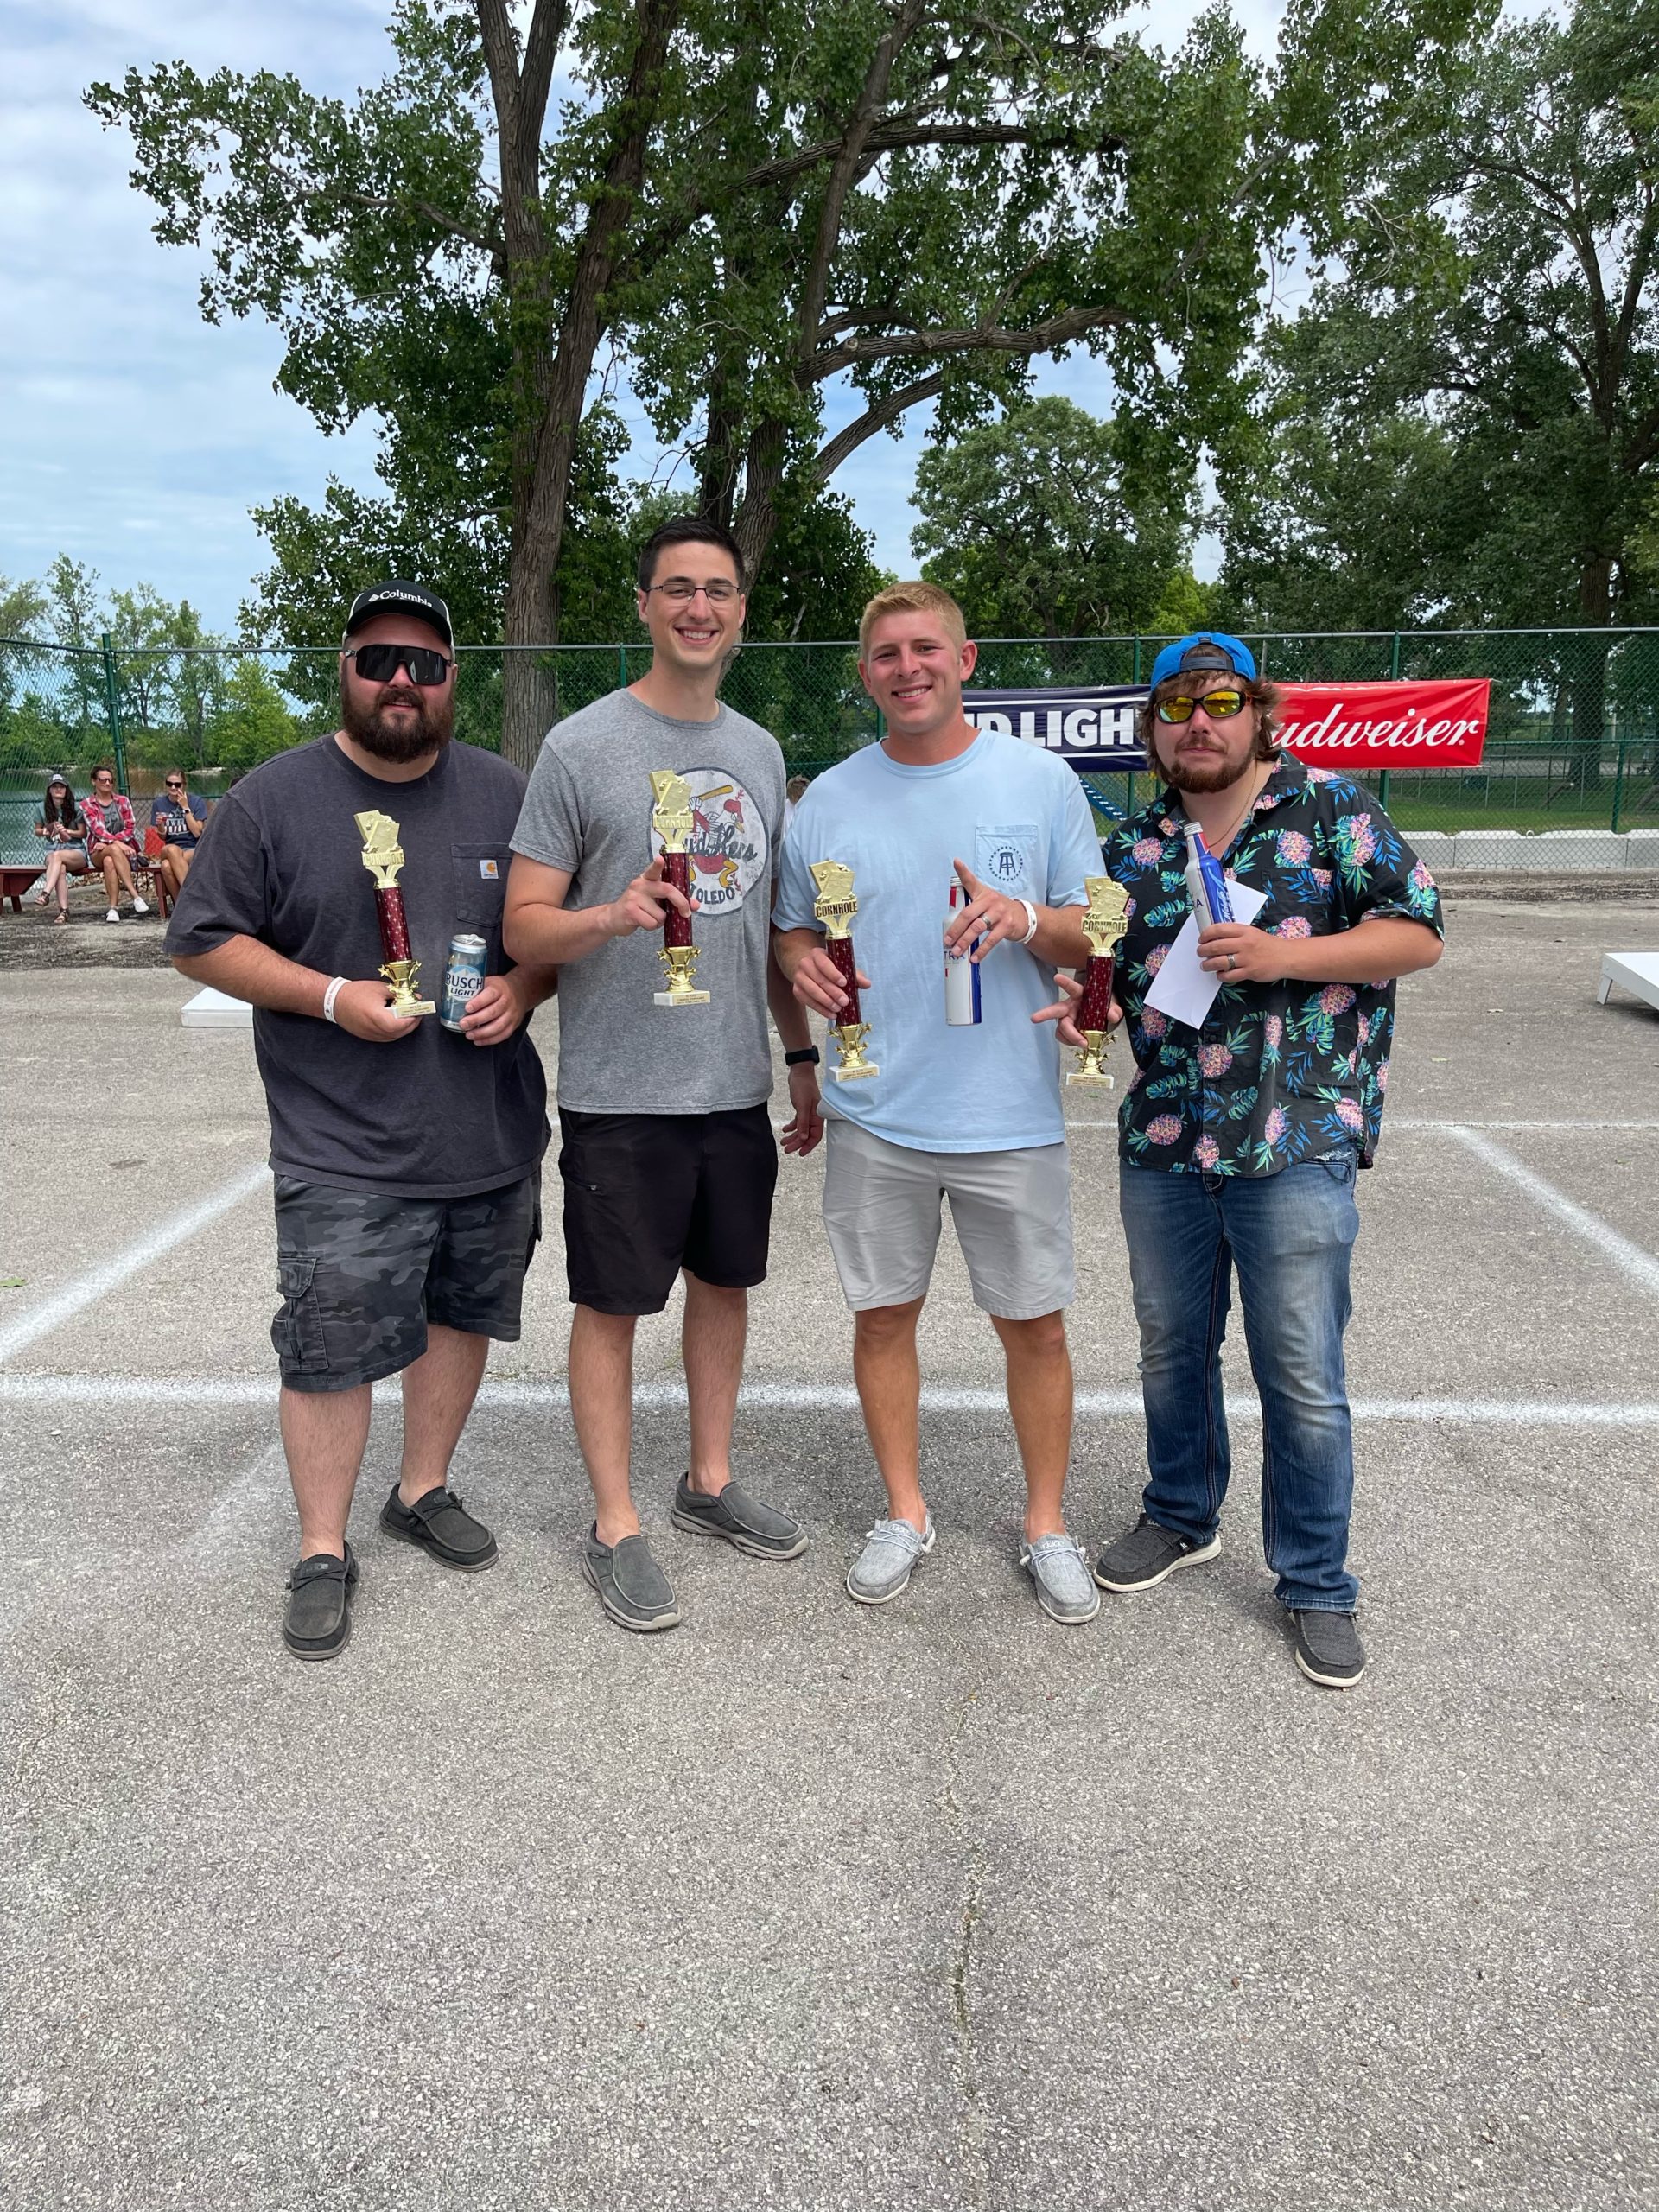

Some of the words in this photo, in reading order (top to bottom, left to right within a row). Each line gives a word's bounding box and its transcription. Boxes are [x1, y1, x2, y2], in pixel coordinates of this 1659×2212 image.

[380, 589, 432, 607] Columbia
[1020, 709, 1139, 747] LIGH
[1270, 703, 1480, 748] udweiser
[690, 882, 735, 906] TOLEDO
[815, 900, 858, 918] CORNHOLE
[445, 971, 484, 990] BUSCH
[450, 987, 476, 996] LIGHT
